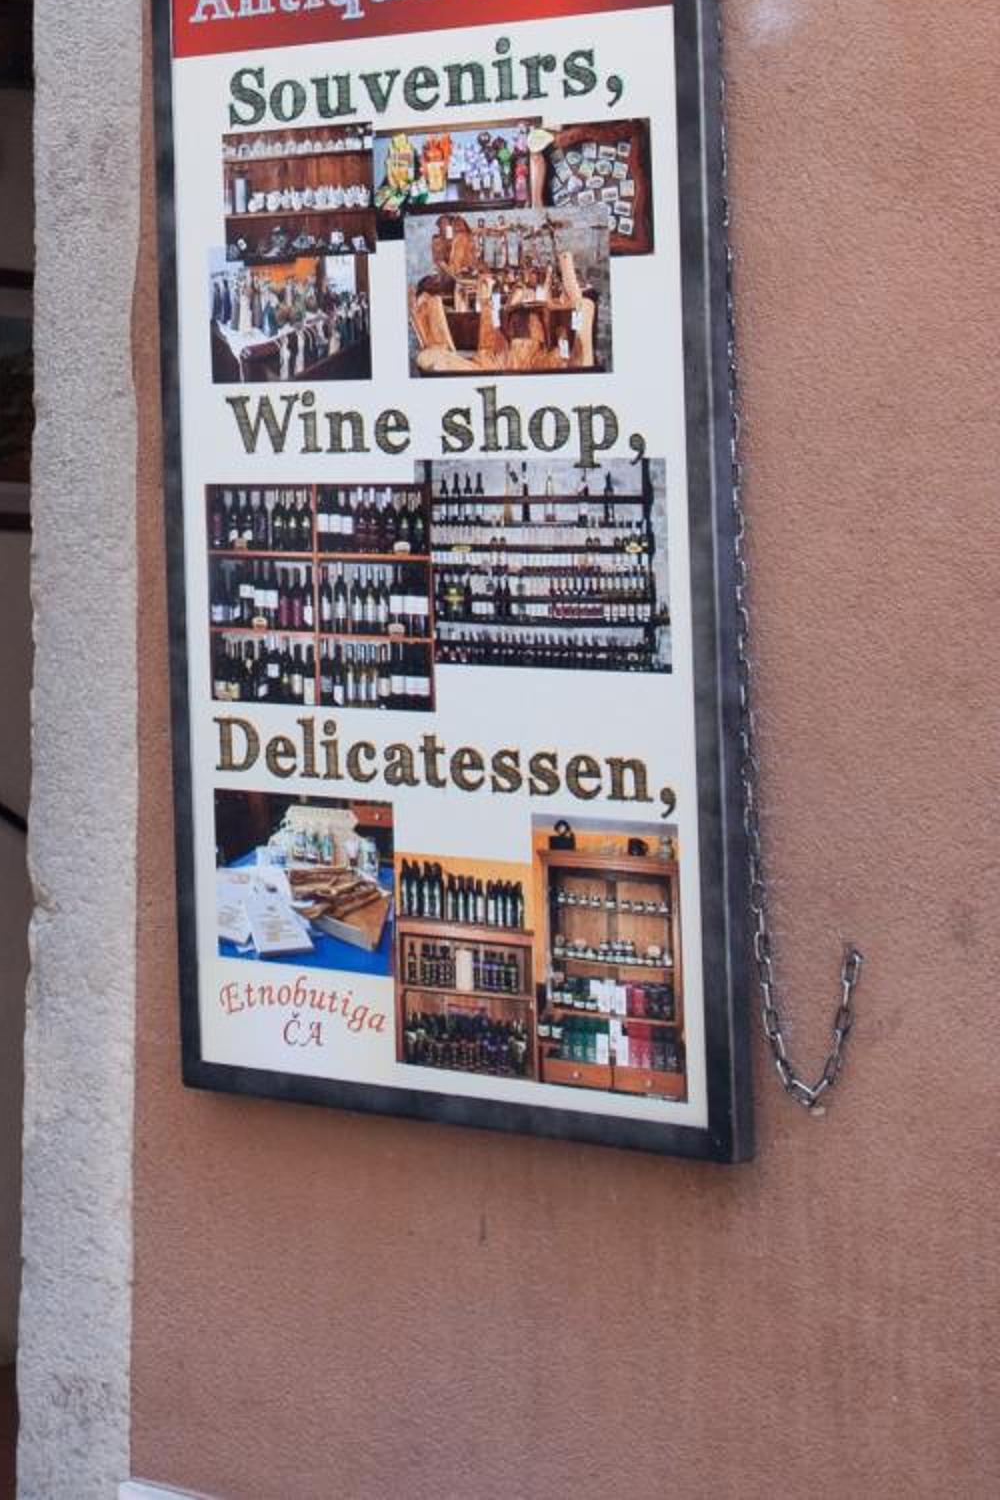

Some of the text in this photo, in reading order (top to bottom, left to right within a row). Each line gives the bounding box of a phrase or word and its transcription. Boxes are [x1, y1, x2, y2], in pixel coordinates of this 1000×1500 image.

[227, 37, 624, 127] Souvenirs,
[225, 385, 648, 468] Wine shop,
[213, 715, 678, 819] Delicatessen,
[219, 975, 387, 1033] Etnobutiga
[283, 1011, 324, 1047] ČA
